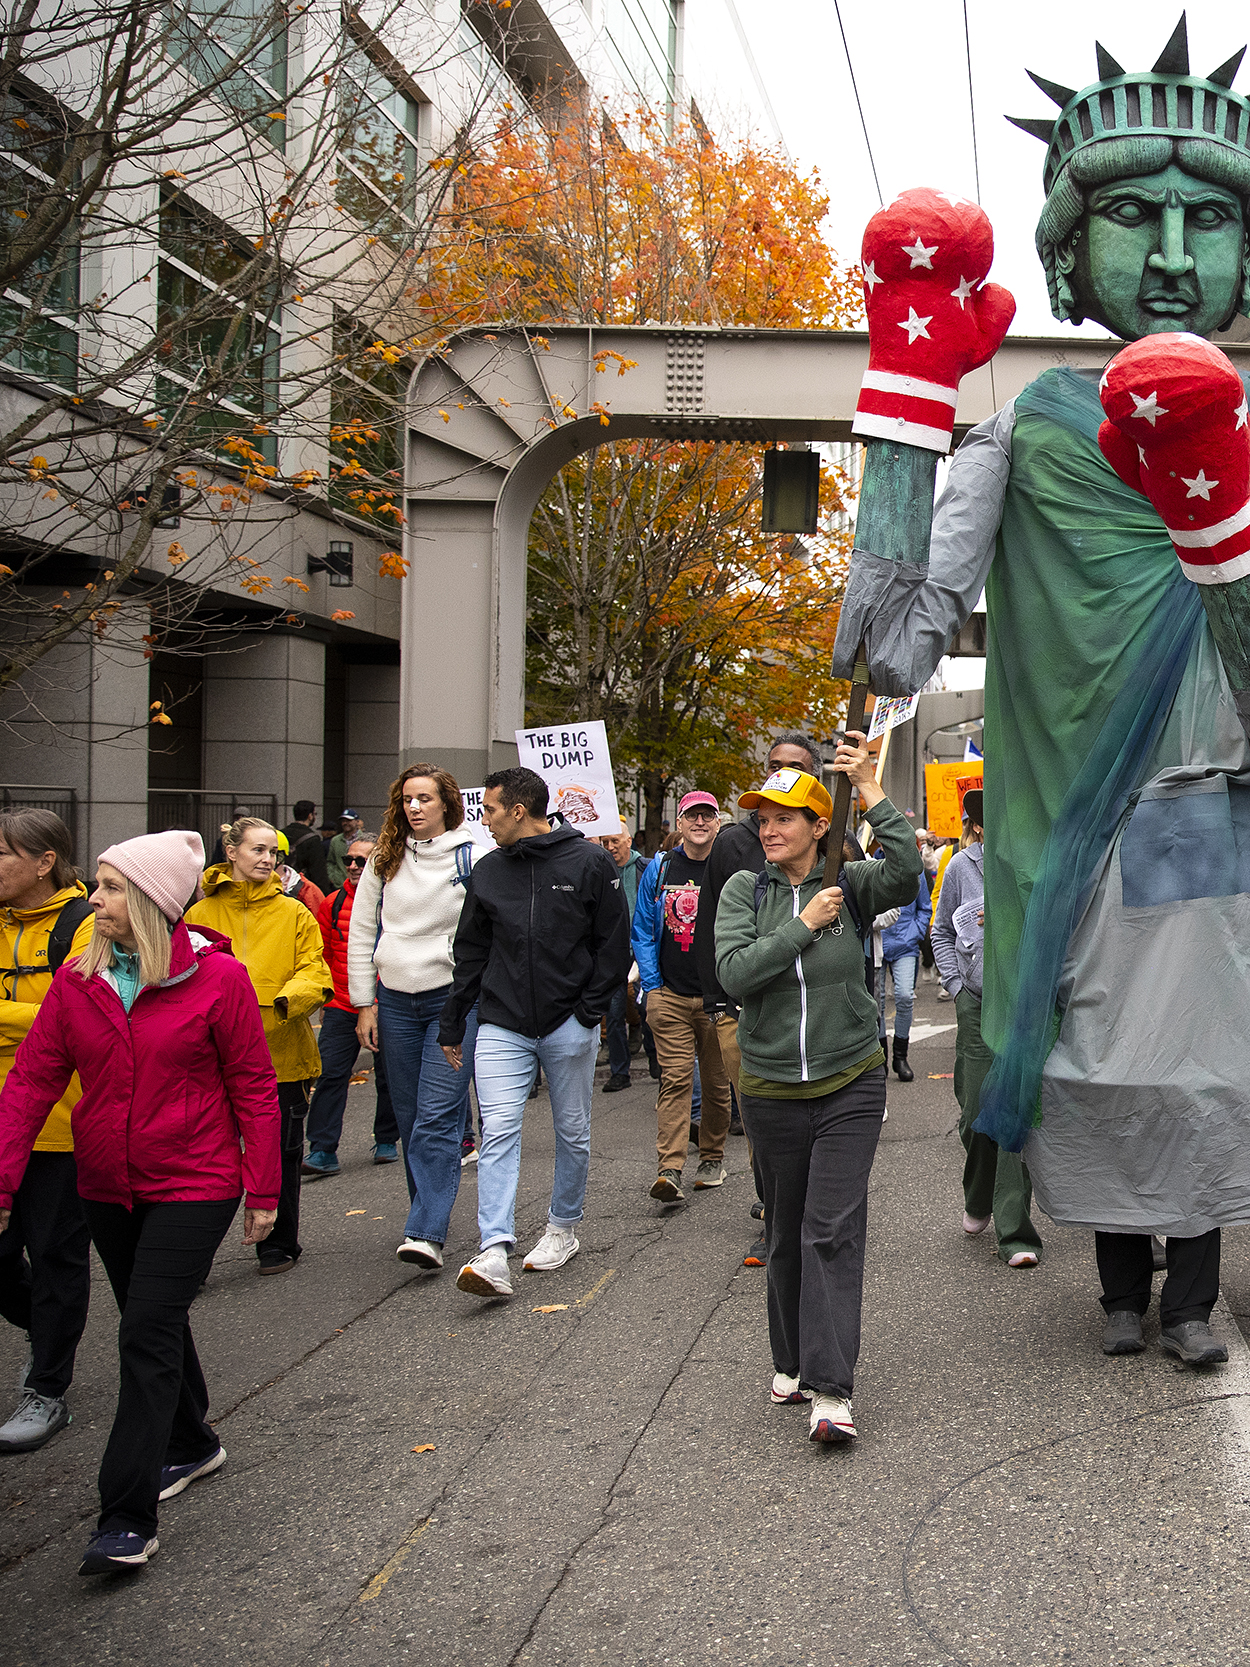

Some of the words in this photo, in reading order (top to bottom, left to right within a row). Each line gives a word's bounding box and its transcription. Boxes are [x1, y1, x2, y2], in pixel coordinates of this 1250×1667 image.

[525, 733, 555, 748] THE
[561, 731, 588, 748] BIG
[542, 751, 594, 769] DUMP
[957, 778, 971, 792] WE
[35, 949, 47, 957] OR
